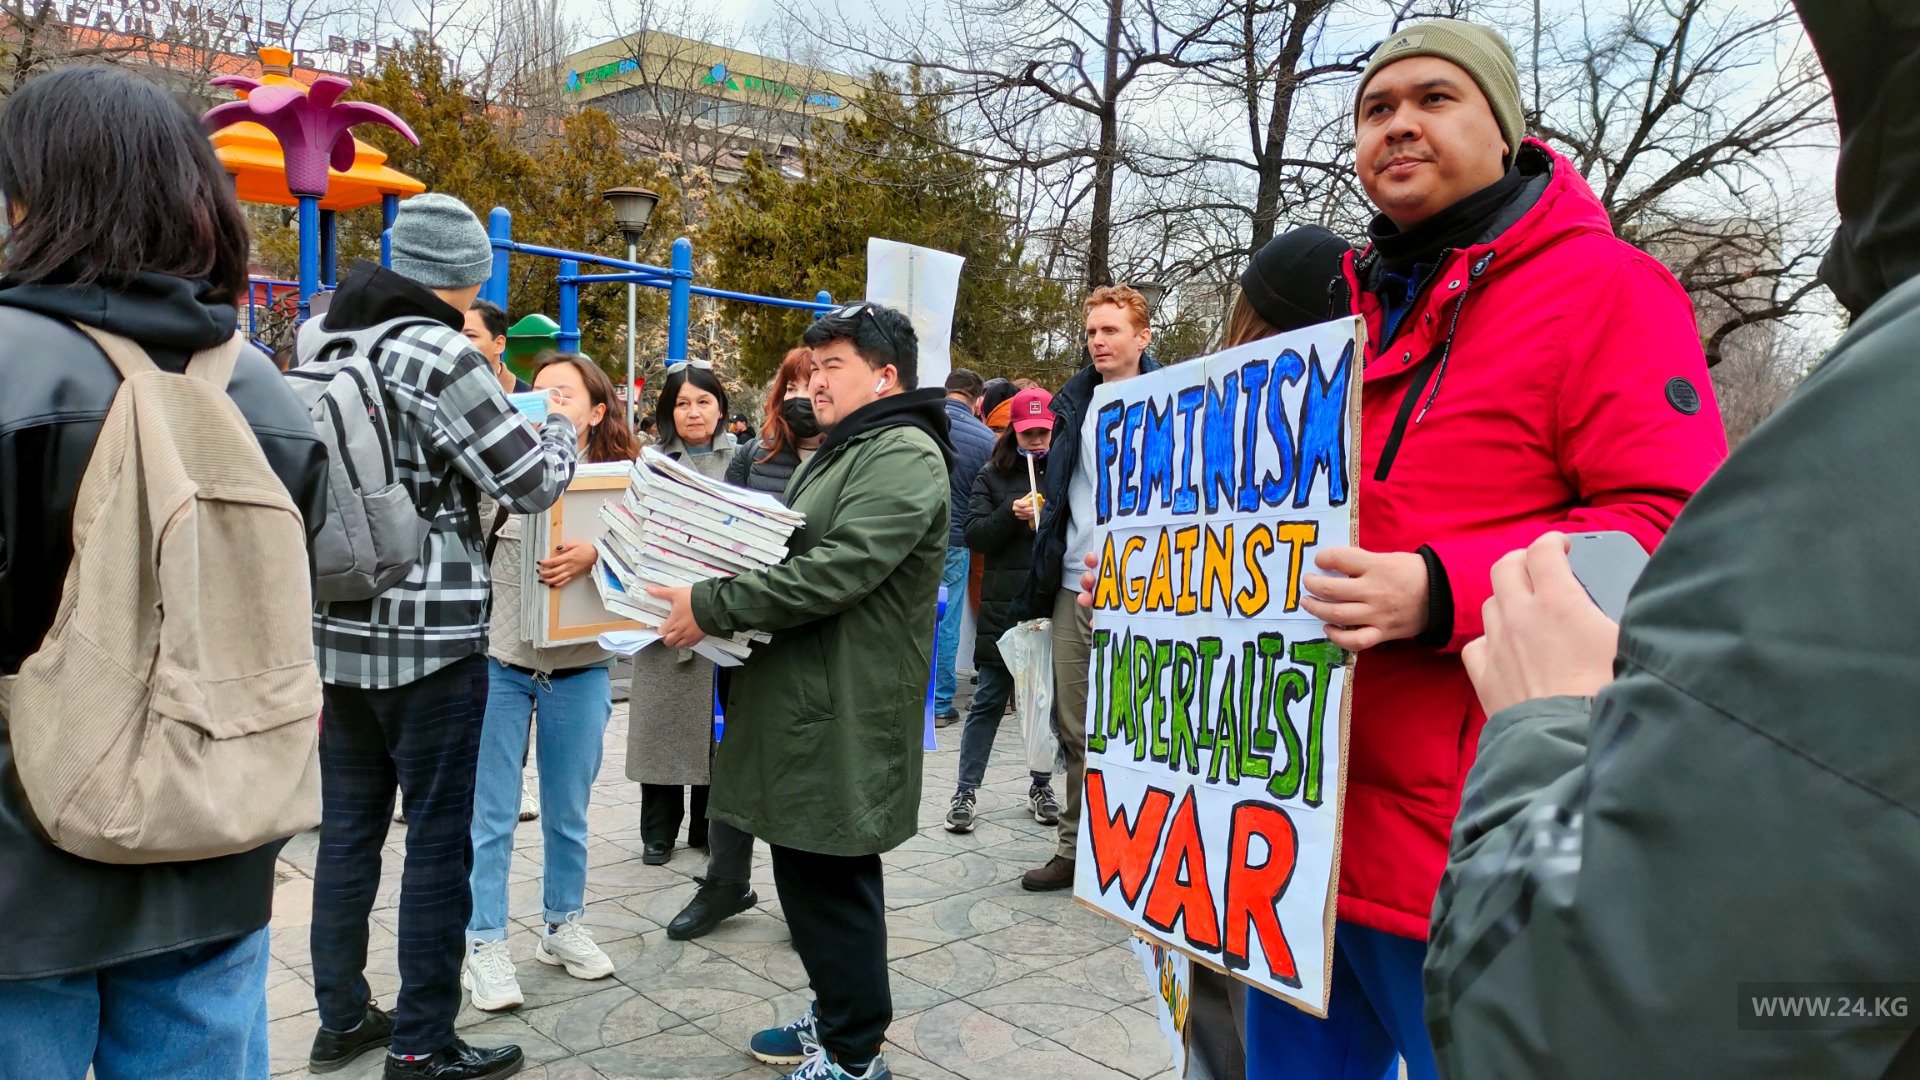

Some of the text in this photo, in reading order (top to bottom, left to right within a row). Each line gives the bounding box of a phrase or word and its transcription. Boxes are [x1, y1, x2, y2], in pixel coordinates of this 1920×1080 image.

[1095, 338, 1355, 526] FEMINISM
[1092, 520, 1319, 618] AGAINST
[1086, 626, 1348, 808] IMPERIALIST
[1085, 768, 1303, 988] WAR
